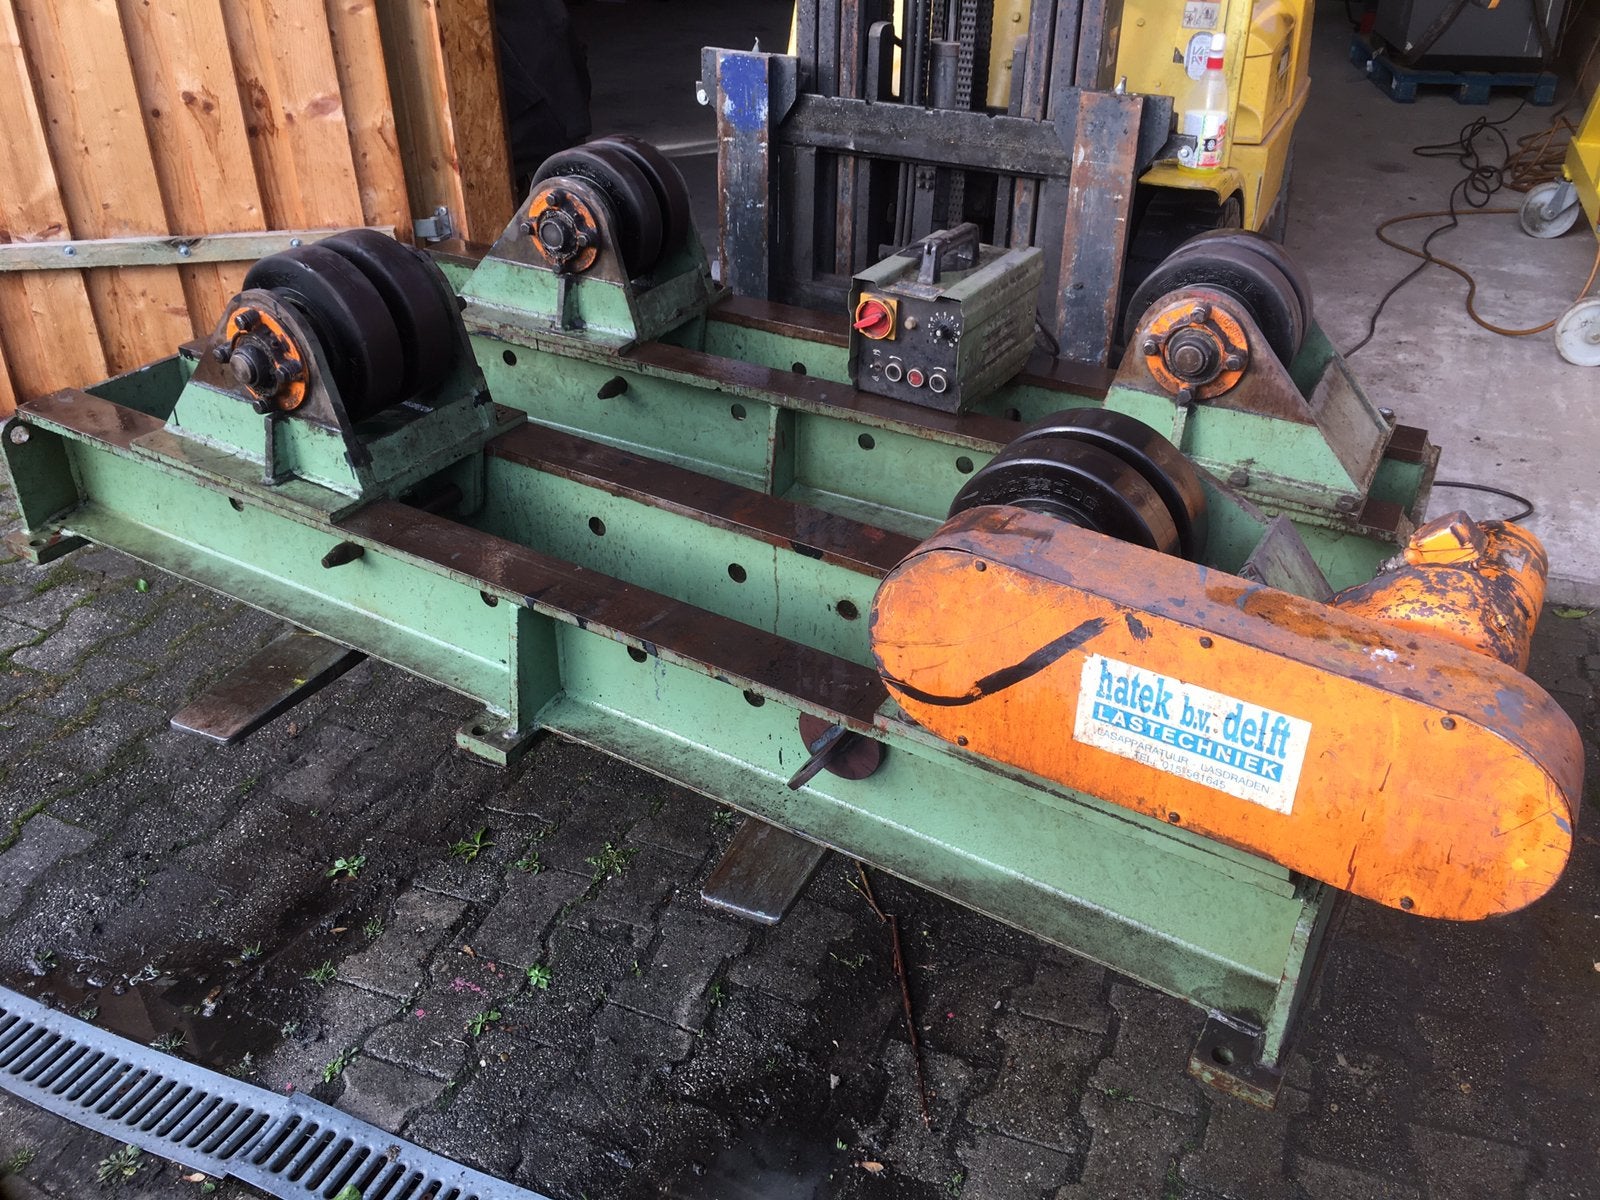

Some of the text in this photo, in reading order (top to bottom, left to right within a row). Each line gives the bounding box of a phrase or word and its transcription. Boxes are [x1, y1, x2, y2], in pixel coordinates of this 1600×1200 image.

[1096, 659, 1291, 759] hatek b.v. delft
[1097, 704, 1279, 780] LASTECHNIEK
[1201, 763, 1270, 794] LASDRADEN
